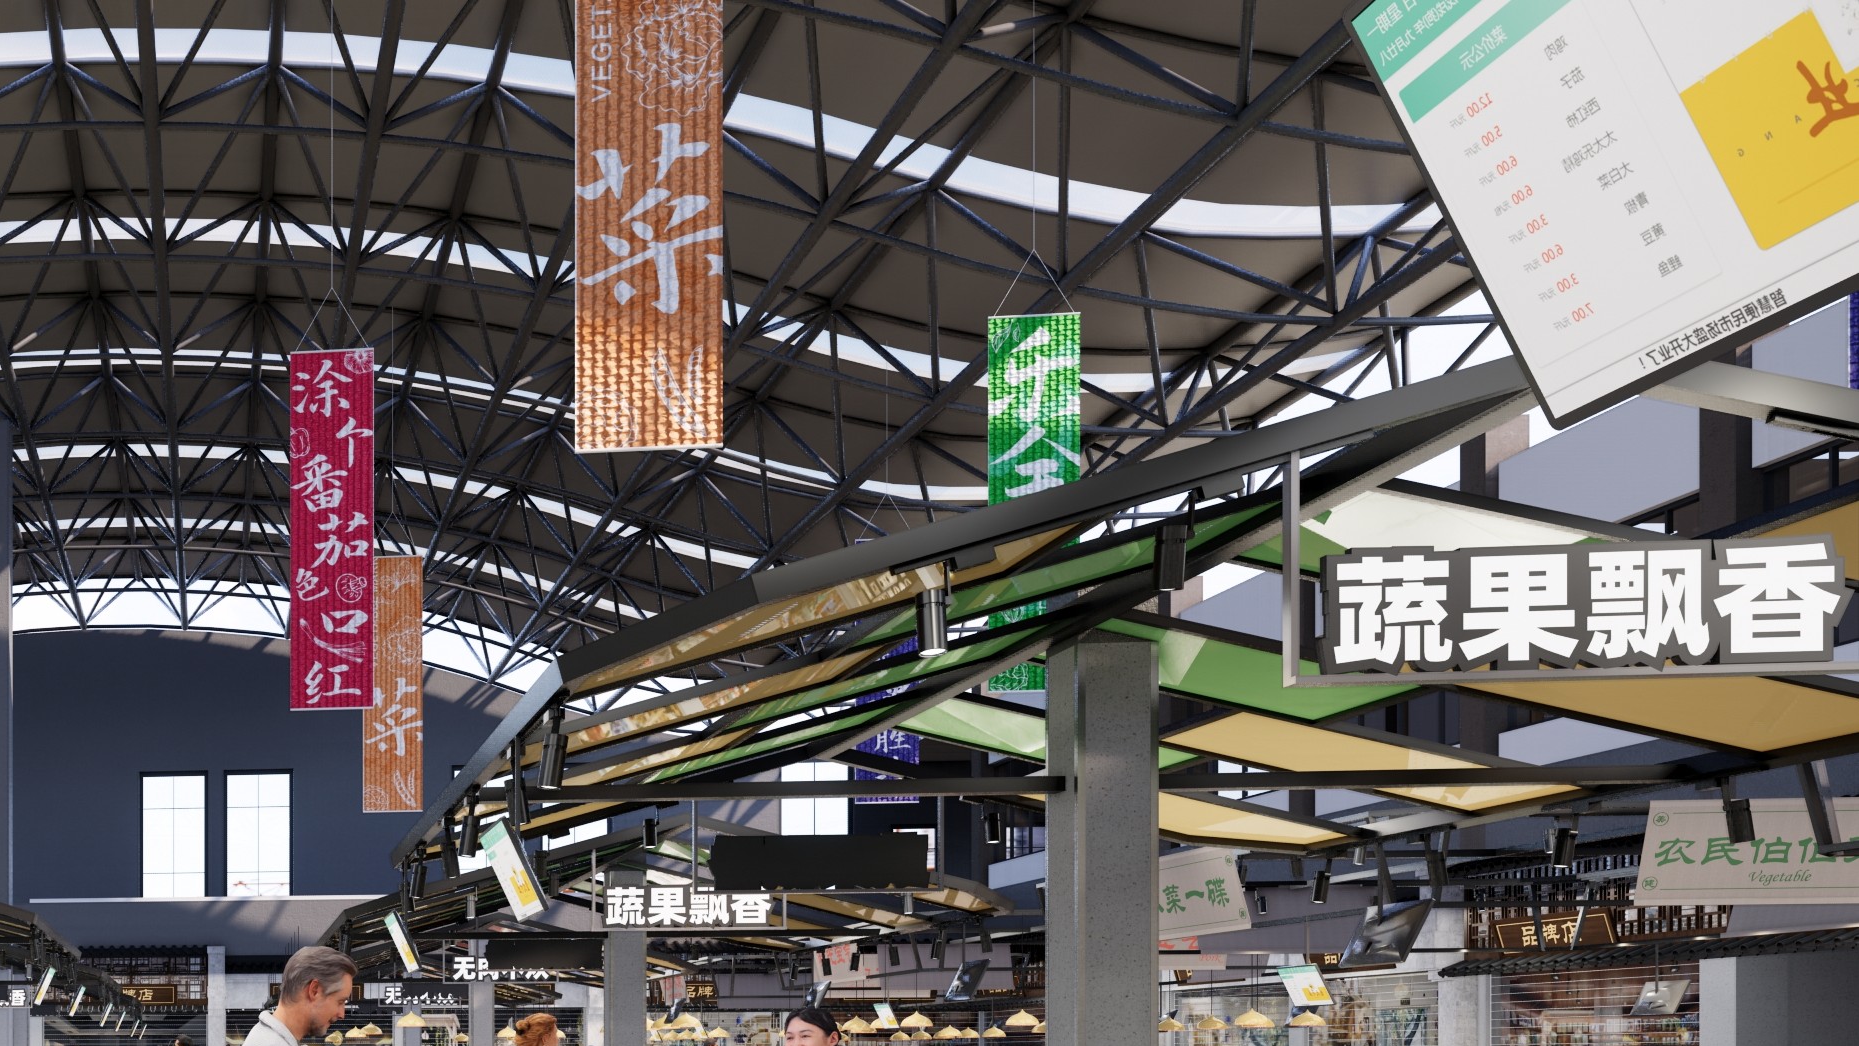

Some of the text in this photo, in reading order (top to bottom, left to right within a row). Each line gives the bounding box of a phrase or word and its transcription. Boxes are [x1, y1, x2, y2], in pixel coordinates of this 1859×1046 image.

[591, 0, 612, 102] VEGET
[1333, 543, 1841, 665] 蔬果飘香
[1655, 836, 1859, 866] 农民伯伯
[1159, 877, 1230, 914] 菜一碟
[1749, 869, 1812, 886] Vegetable
[605, 886, 771, 926] 蔬果飘香
